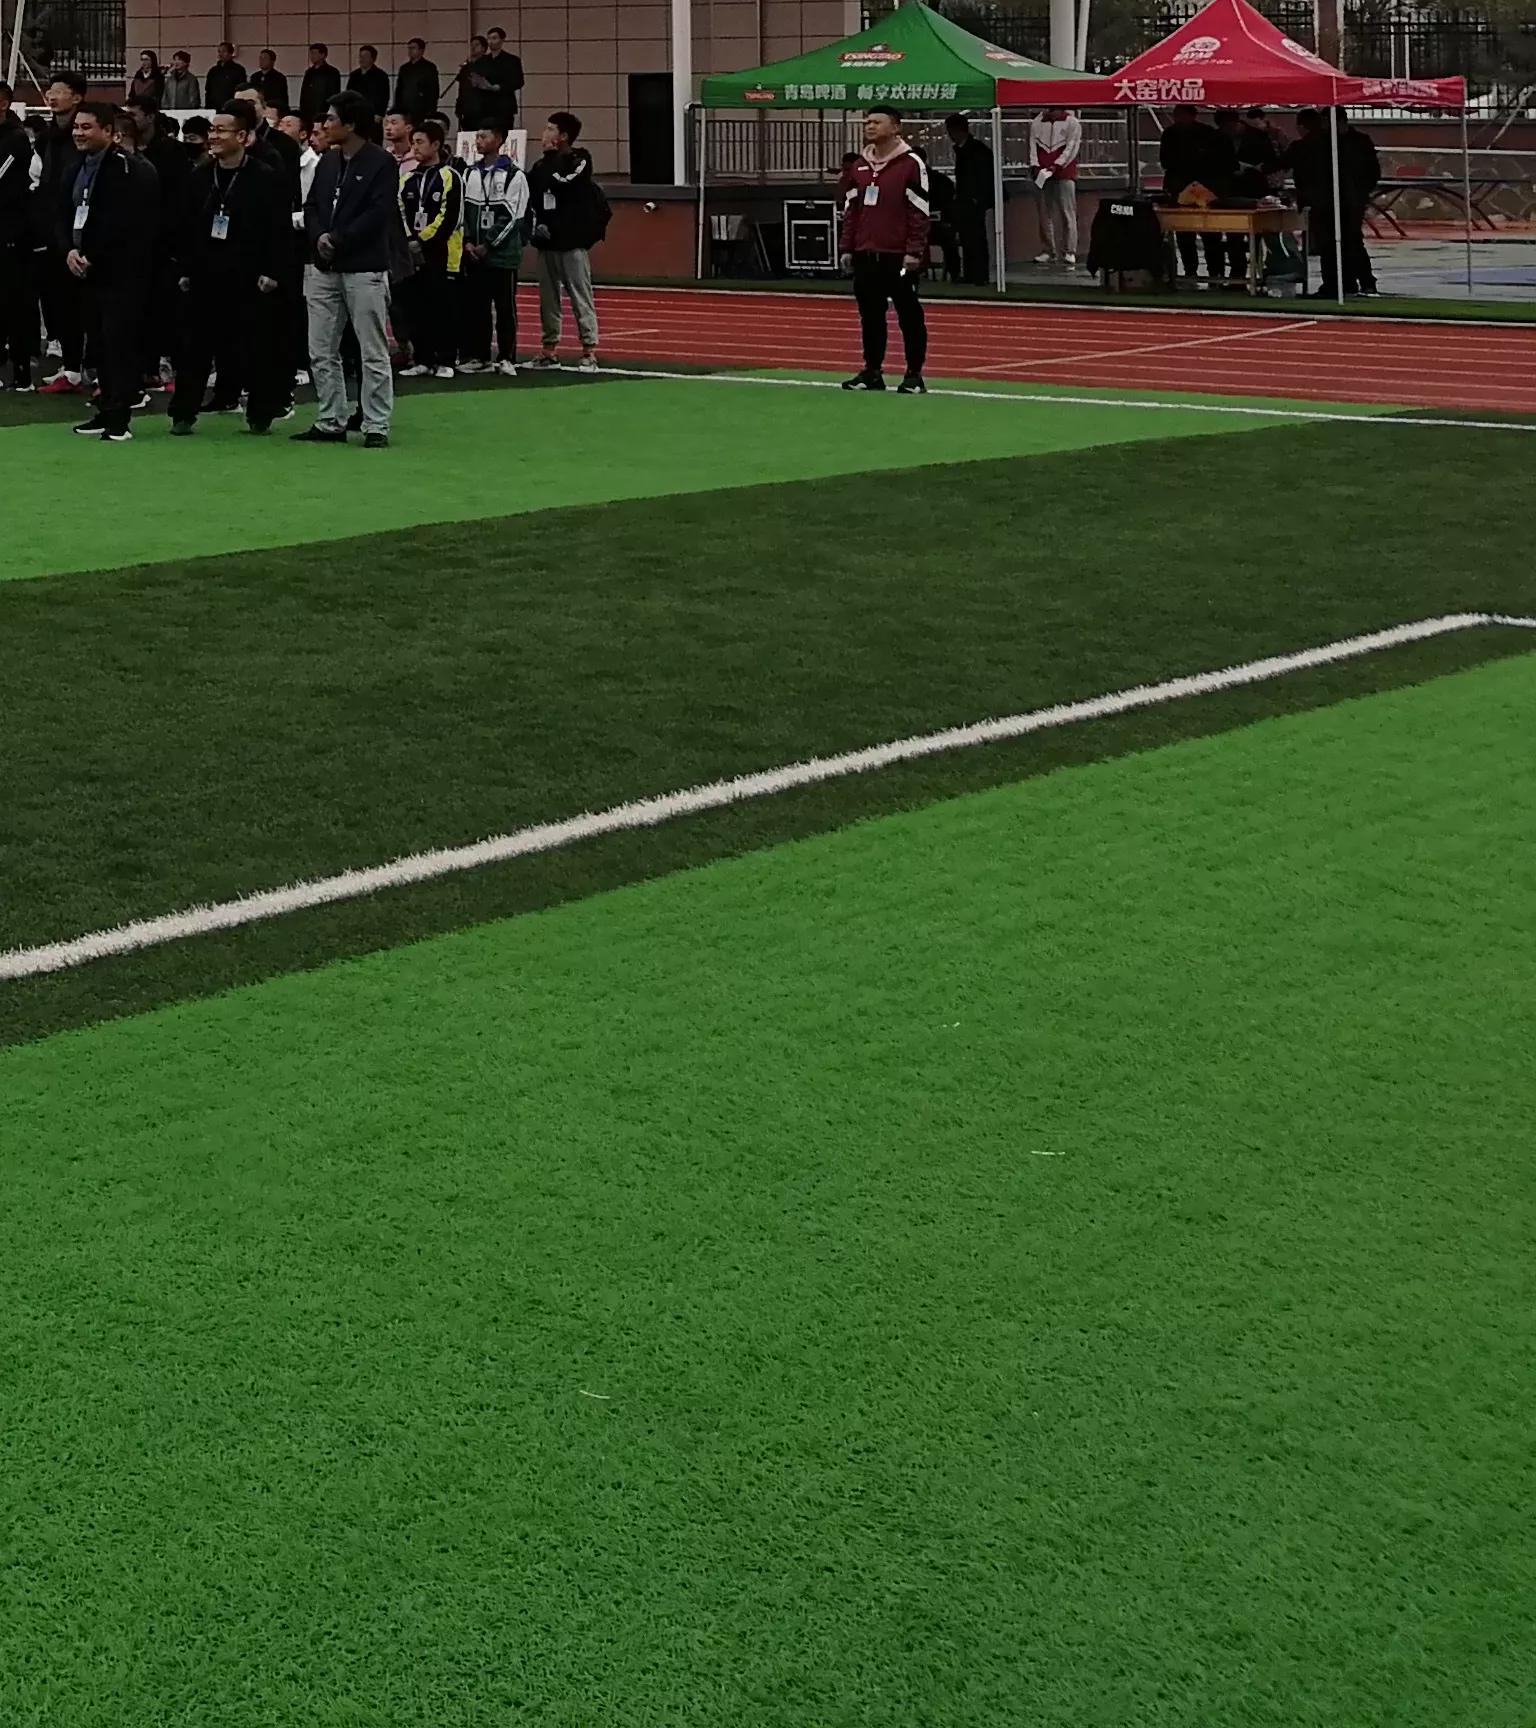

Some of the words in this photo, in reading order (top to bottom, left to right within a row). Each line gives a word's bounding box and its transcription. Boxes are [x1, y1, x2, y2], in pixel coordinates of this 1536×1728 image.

[784, 83, 847, 101] 青岛啤酒
[1113, 78, 1205, 101] 大窑饮品
